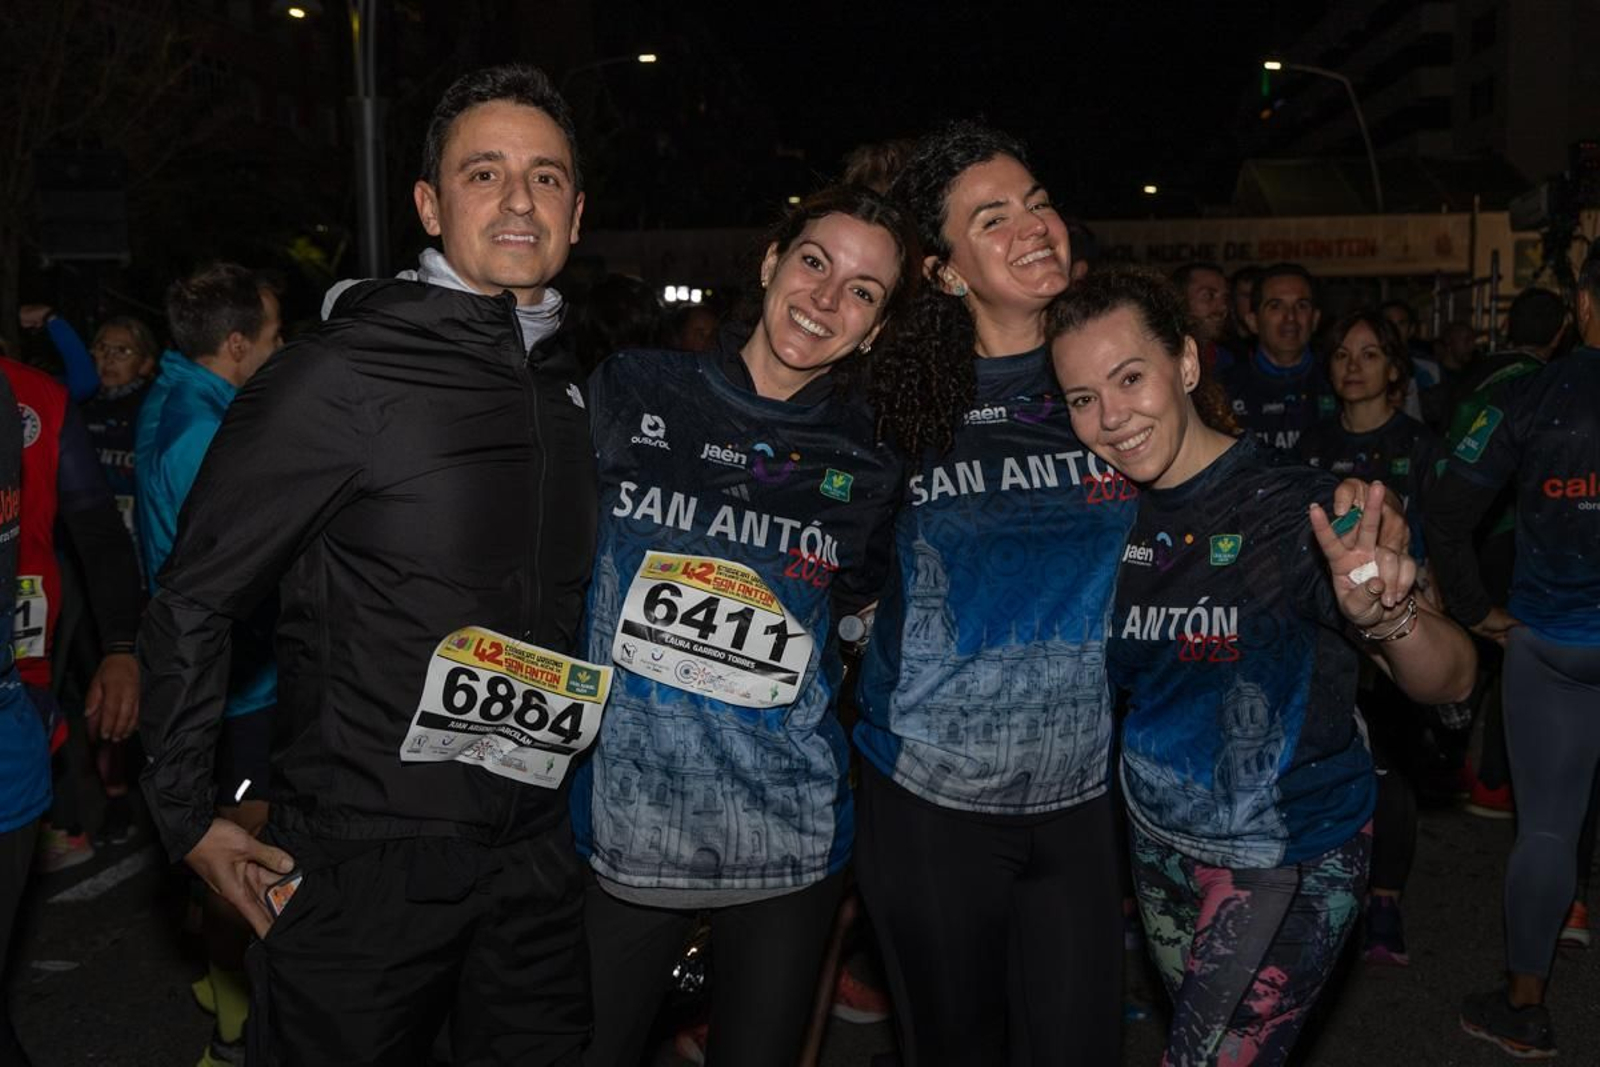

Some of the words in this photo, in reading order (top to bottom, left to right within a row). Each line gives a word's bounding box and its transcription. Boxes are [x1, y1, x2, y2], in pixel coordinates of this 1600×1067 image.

[908, 459, 986, 507] SAN
[1000, 450, 1116, 491] ANTO
[612, 480, 699, 532] SAN
[706, 504, 840, 567] ANTÓN
[681, 561, 716, 585] 42
[713, 576, 735, 592] SAN
[643, 582, 789, 663] 6411
[1121, 596, 1238, 643] ANTÓN
[473, 637, 504, 668] 42
[664, 635, 691, 650] LAURA
[692, 642, 727, 660] GARRIDO
[727, 653, 757, 669] TORRES
[1176, 631, 1241, 663] 2025
[504, 658, 524, 674] SAN
[442, 666, 585, 744] 6864
[447, 720, 469, 731] JUAN
[496, 726, 533, 745] ARCELÁN
